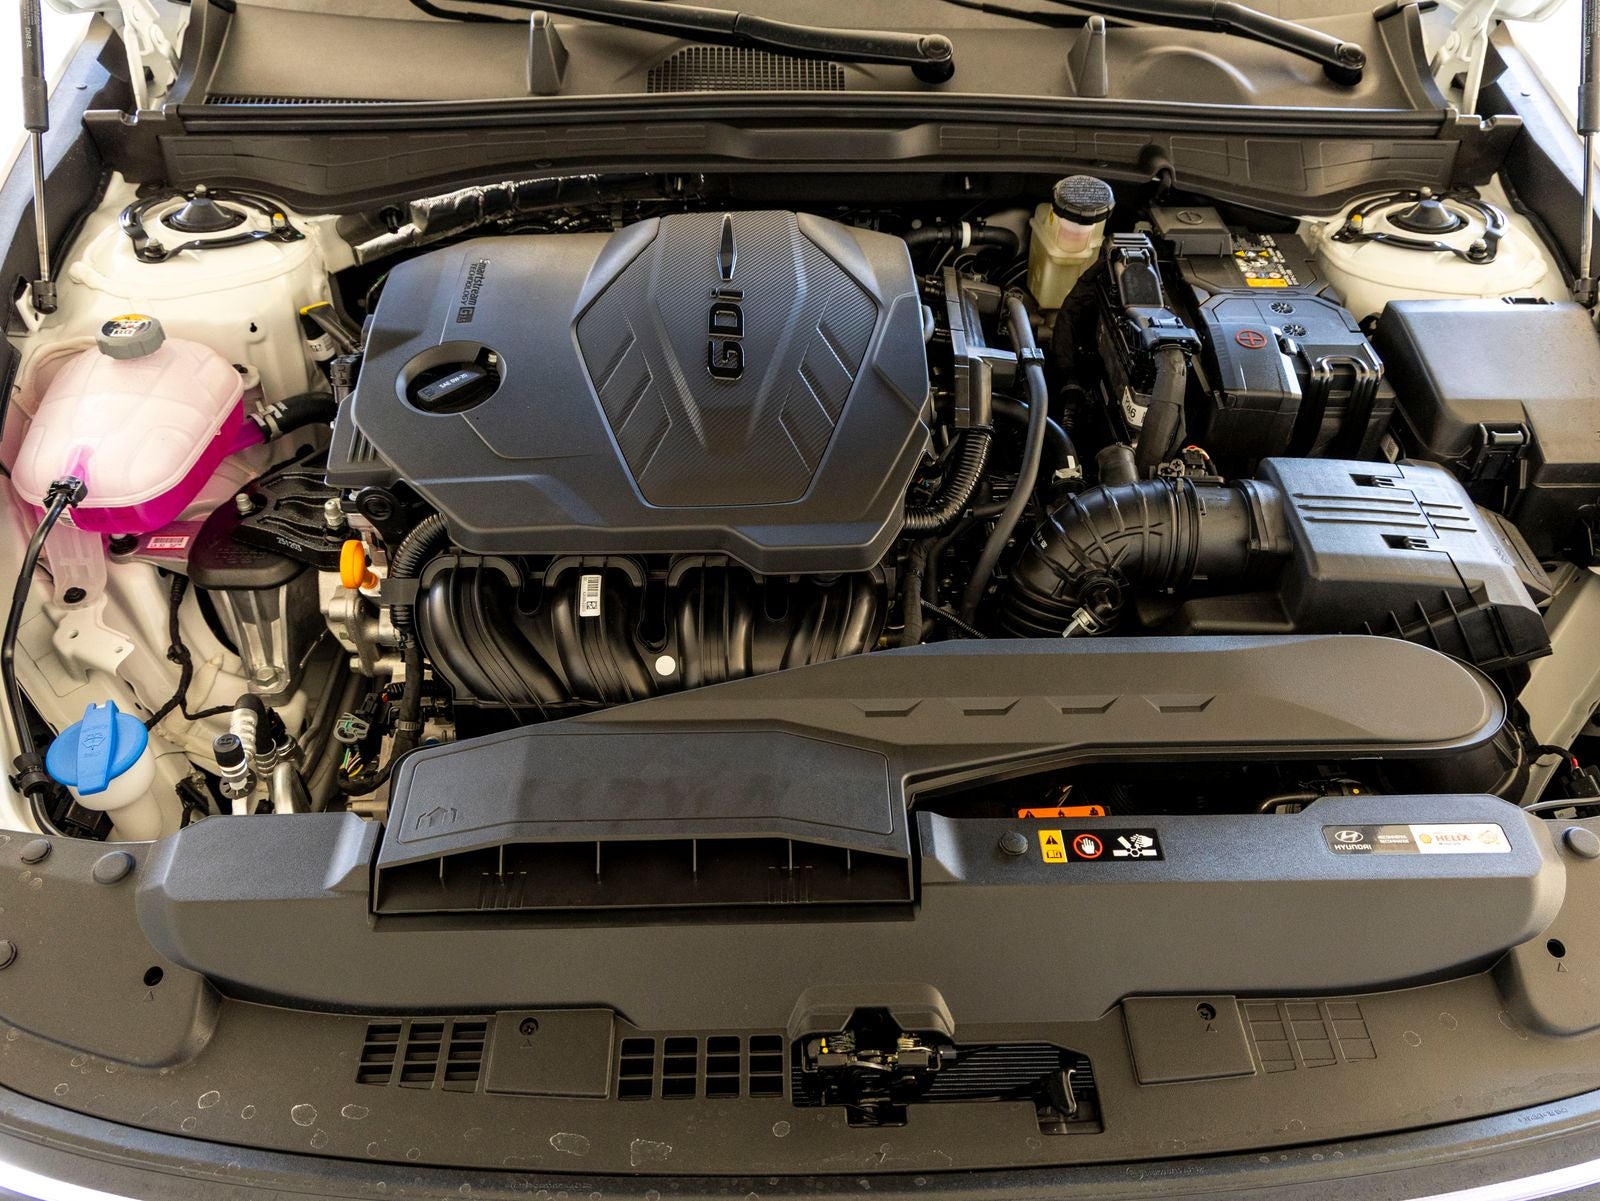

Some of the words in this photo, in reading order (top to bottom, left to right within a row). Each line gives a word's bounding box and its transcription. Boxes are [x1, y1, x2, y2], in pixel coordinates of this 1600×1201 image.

[461, 263, 478, 306] TECHNOLOGY
[468, 258, 490, 306] Smartstream
[707, 287, 745, 381] GDi
[1435, 834, 1471, 842] HELIX
